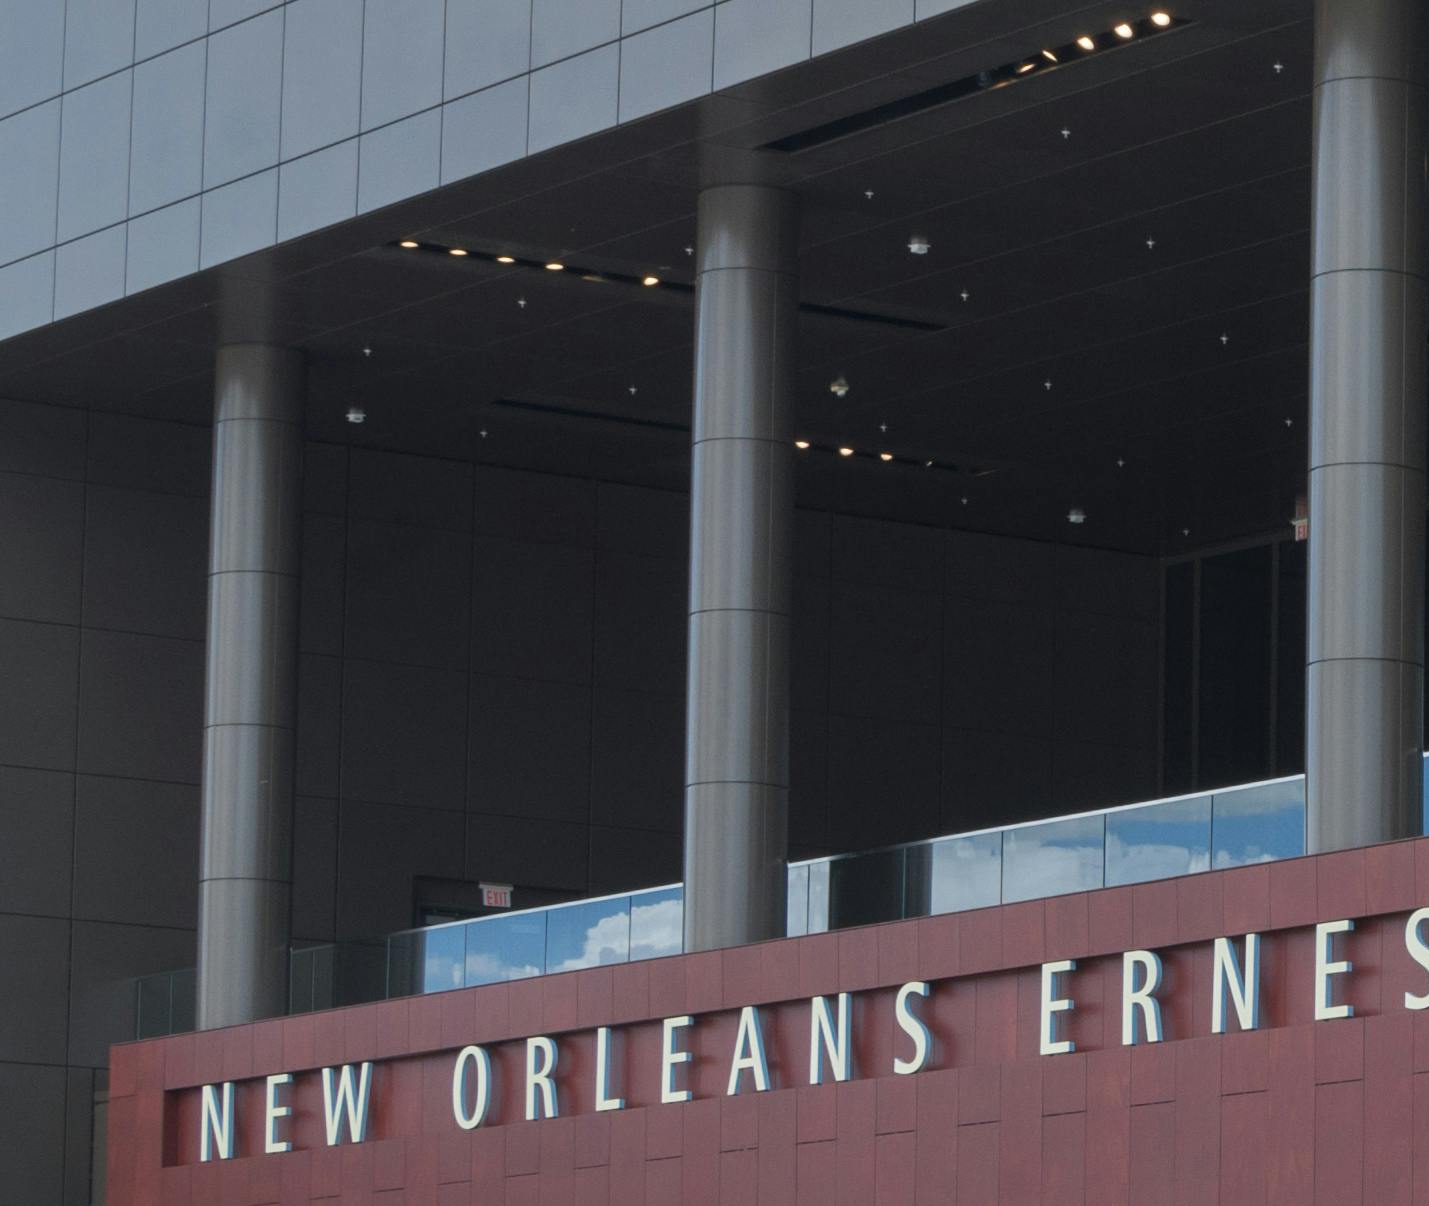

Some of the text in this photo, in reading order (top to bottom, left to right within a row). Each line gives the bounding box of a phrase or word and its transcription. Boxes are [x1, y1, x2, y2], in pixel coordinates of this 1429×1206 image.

[486, 888, 508, 906] EXIT
[200, 1060, 373, 1163] NEW
[451, 980, 934, 1131] ORLEANS
